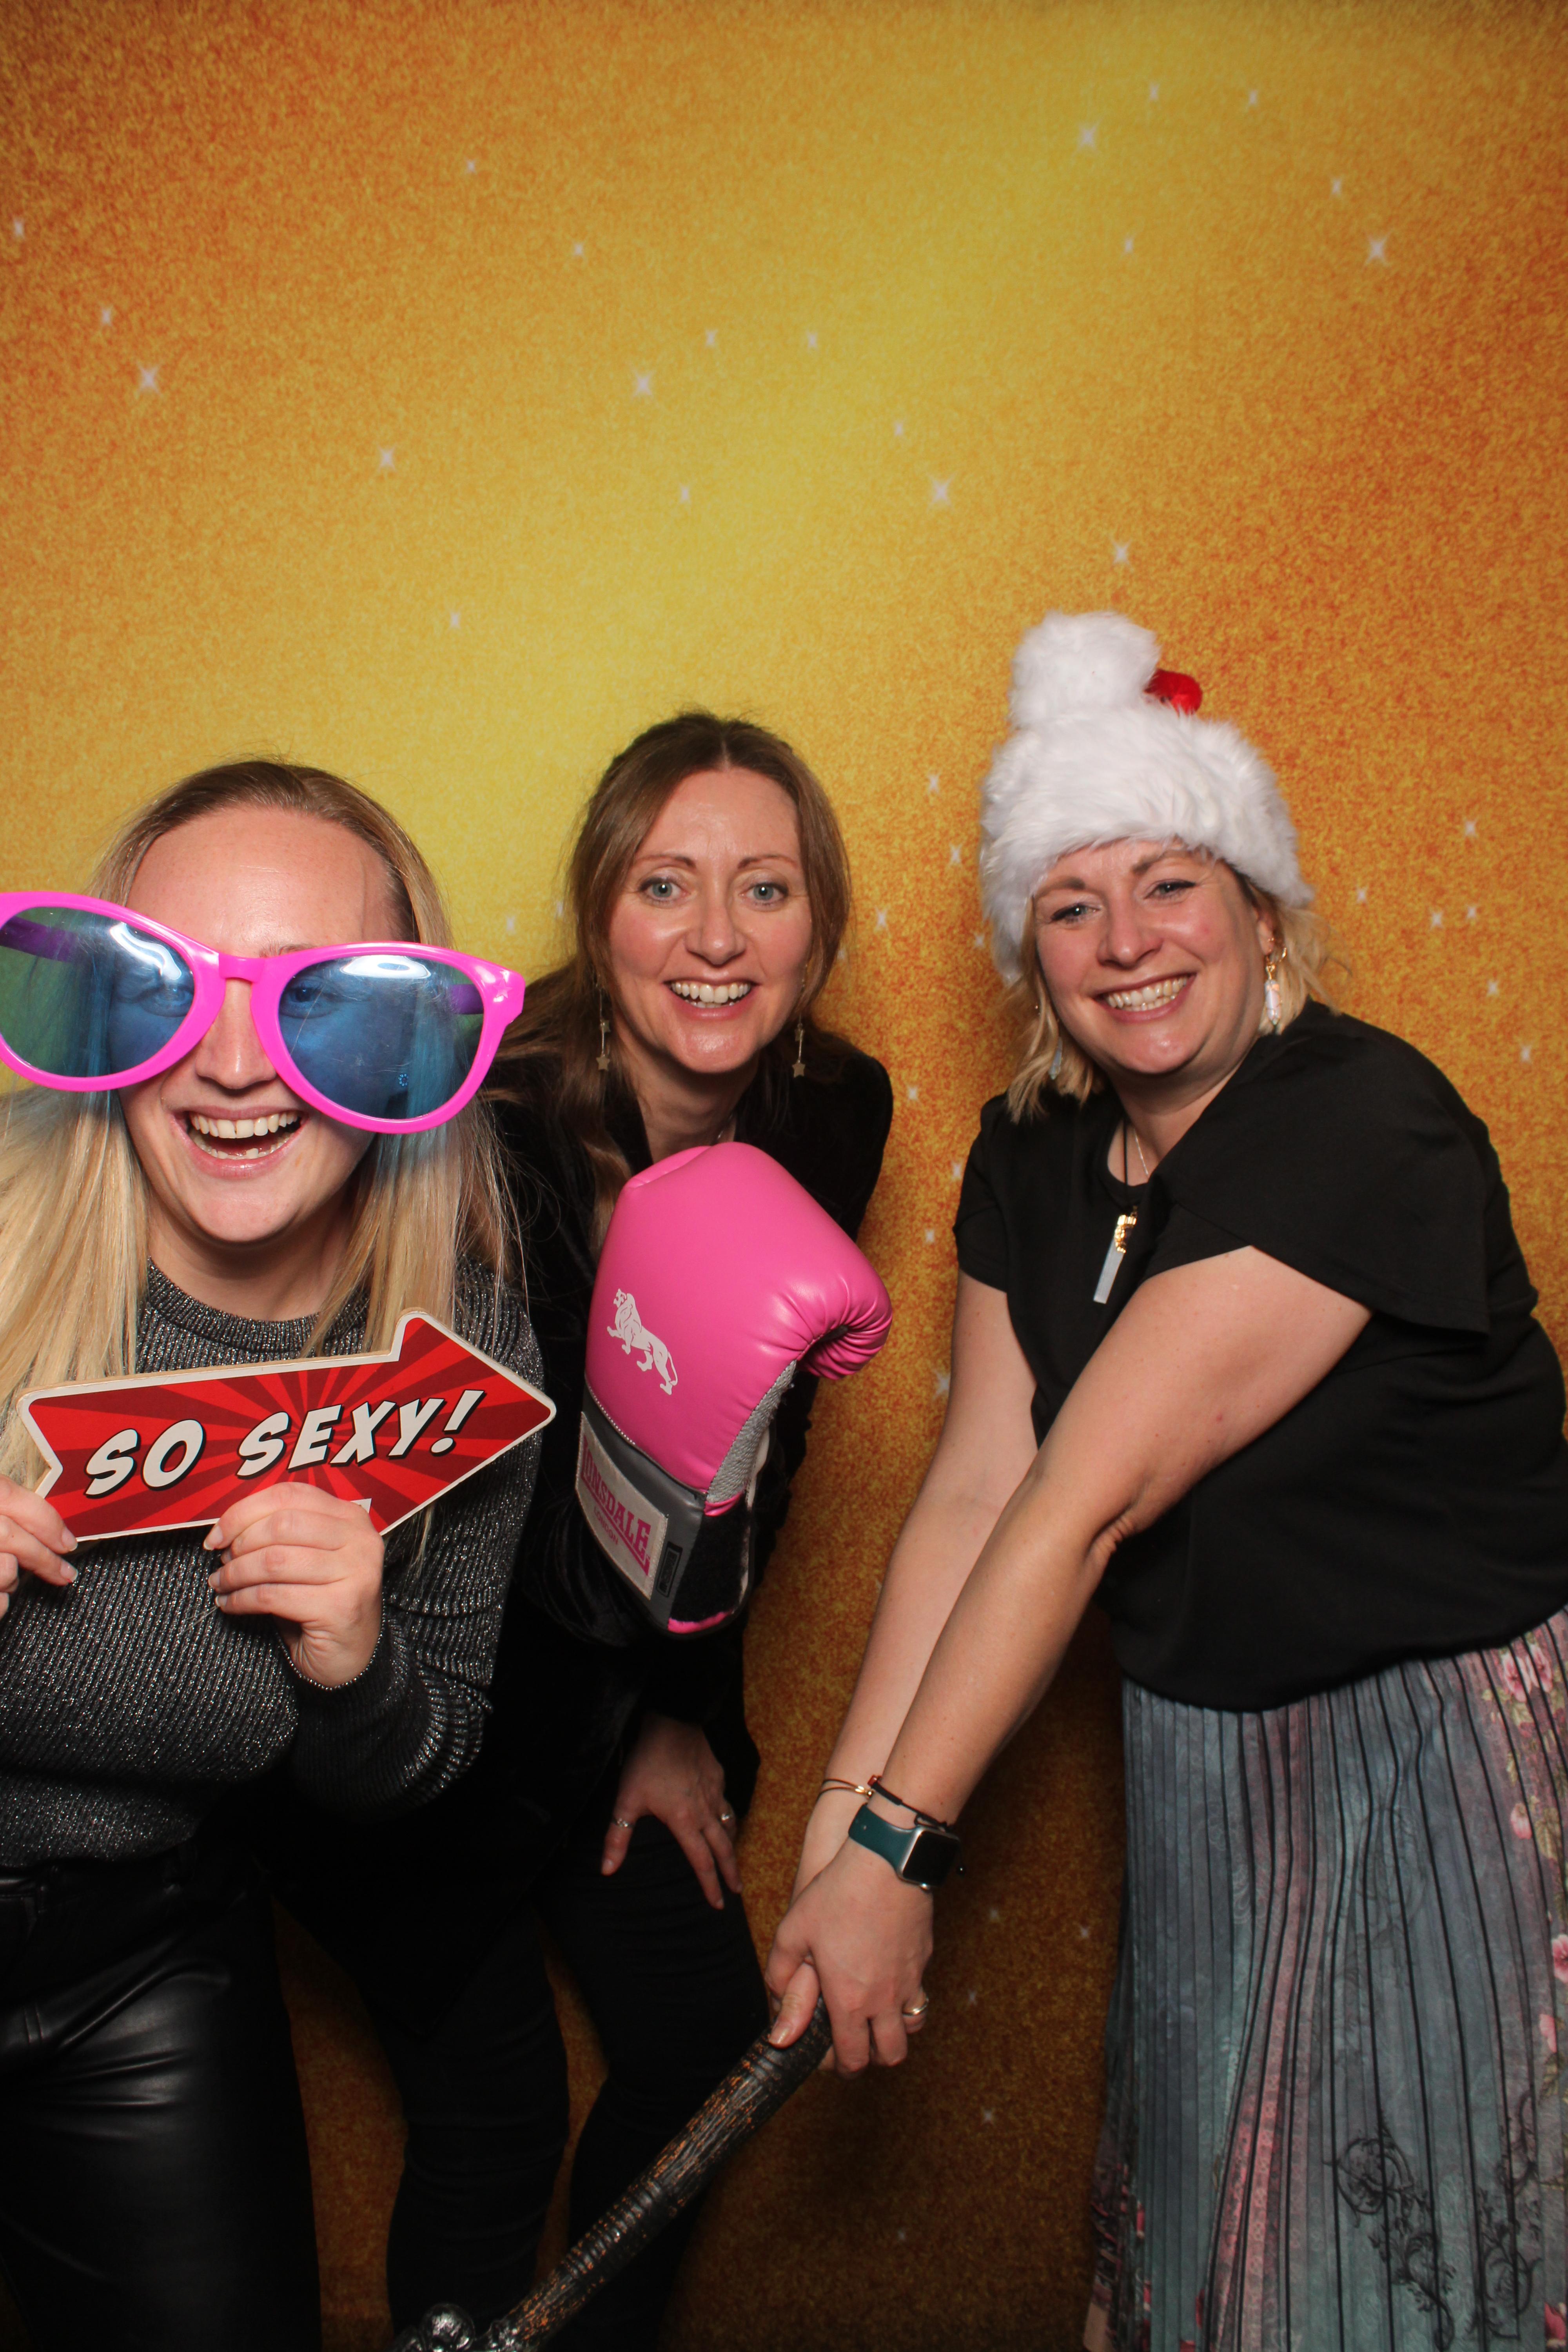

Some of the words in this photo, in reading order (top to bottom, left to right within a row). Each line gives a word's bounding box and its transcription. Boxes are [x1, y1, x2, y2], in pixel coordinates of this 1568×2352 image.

[84, 1419, 206, 1499] SO
[236, 1390, 485, 1477] SEXY!
[581, 1434, 651, 1575] LONSDALE
